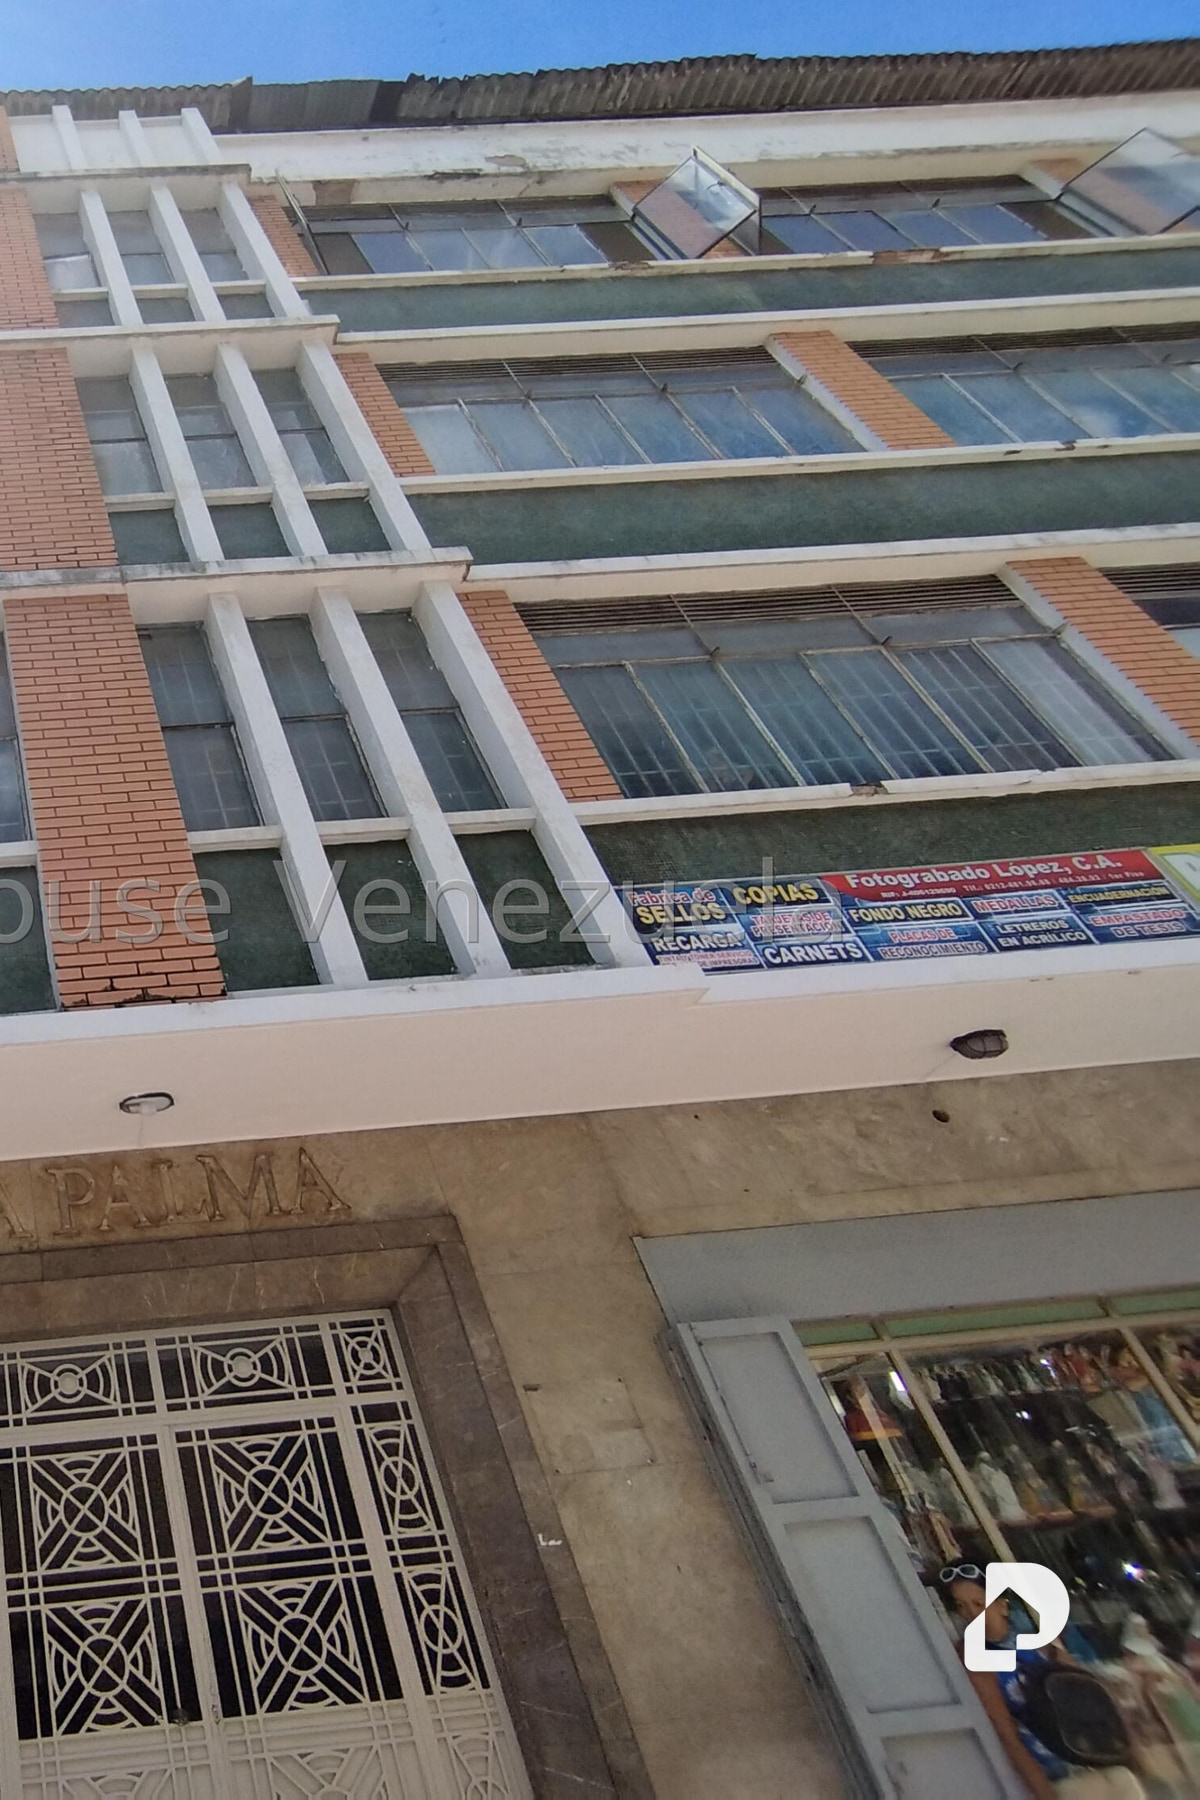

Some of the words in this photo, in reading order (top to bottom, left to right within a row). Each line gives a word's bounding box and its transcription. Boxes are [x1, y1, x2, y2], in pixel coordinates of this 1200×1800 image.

[845, 866, 990, 888] Fotograbado
[992, 859, 1070, 878] López,
[1072, 855, 1122, 870] C.A.
[628, 888, 691, 906] Fabrica
[693, 887, 716, 902] de
[732, 882, 820, 904] COPIAS
[636, 902, 726, 924] SELLOS
[850, 906, 905, 922] FONDO
[905, 902, 962, 919] NEGRO
[972, 894, 1057, 913] MEDALLAS
[752, 913, 811, 926] TARJETAS
[813, 912, 832, 923] DE
[996, 919, 1069, 934] LETREROS
[1091, 909, 1185, 926] EMPASTADO
[889, 928, 936, 943] PLACAS
[937, 927, 955, 939] DE
[997, 936, 1017, 947] EN
[1019, 930, 1087, 946] ACRÍLICO
[1111, 926, 1138, 938] DE
[1138, 921, 1186, 936] TESIS
[652, 932, 743, 952] RECARGA
[879, 941, 986, 959] RECONOCIMIENTO
[763, 942, 863, 965] CARNETS
[45, 1146, 352, 1238] PALMA
